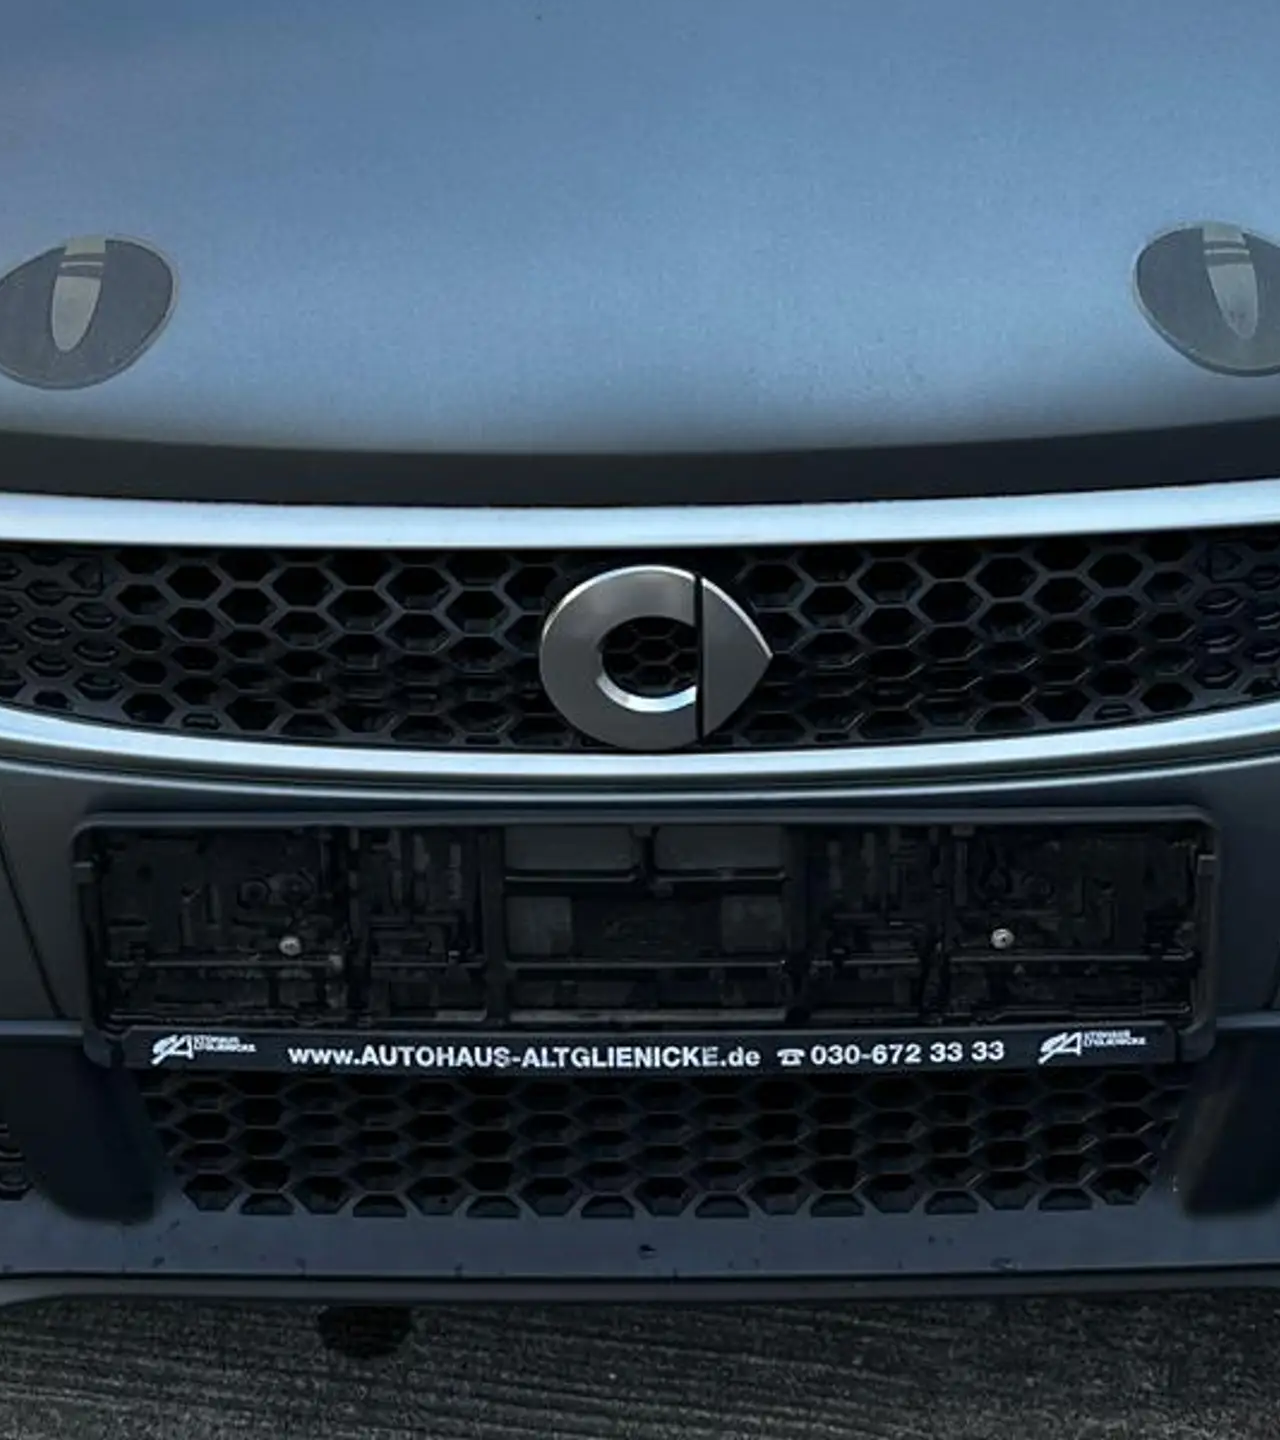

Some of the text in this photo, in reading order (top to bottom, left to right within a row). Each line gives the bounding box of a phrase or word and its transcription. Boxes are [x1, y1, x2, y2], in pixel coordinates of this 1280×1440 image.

[287, 1040, 1005, 1069] www.AUTOHAUS-ALTGLIENICKE.de 030-672 33 33
